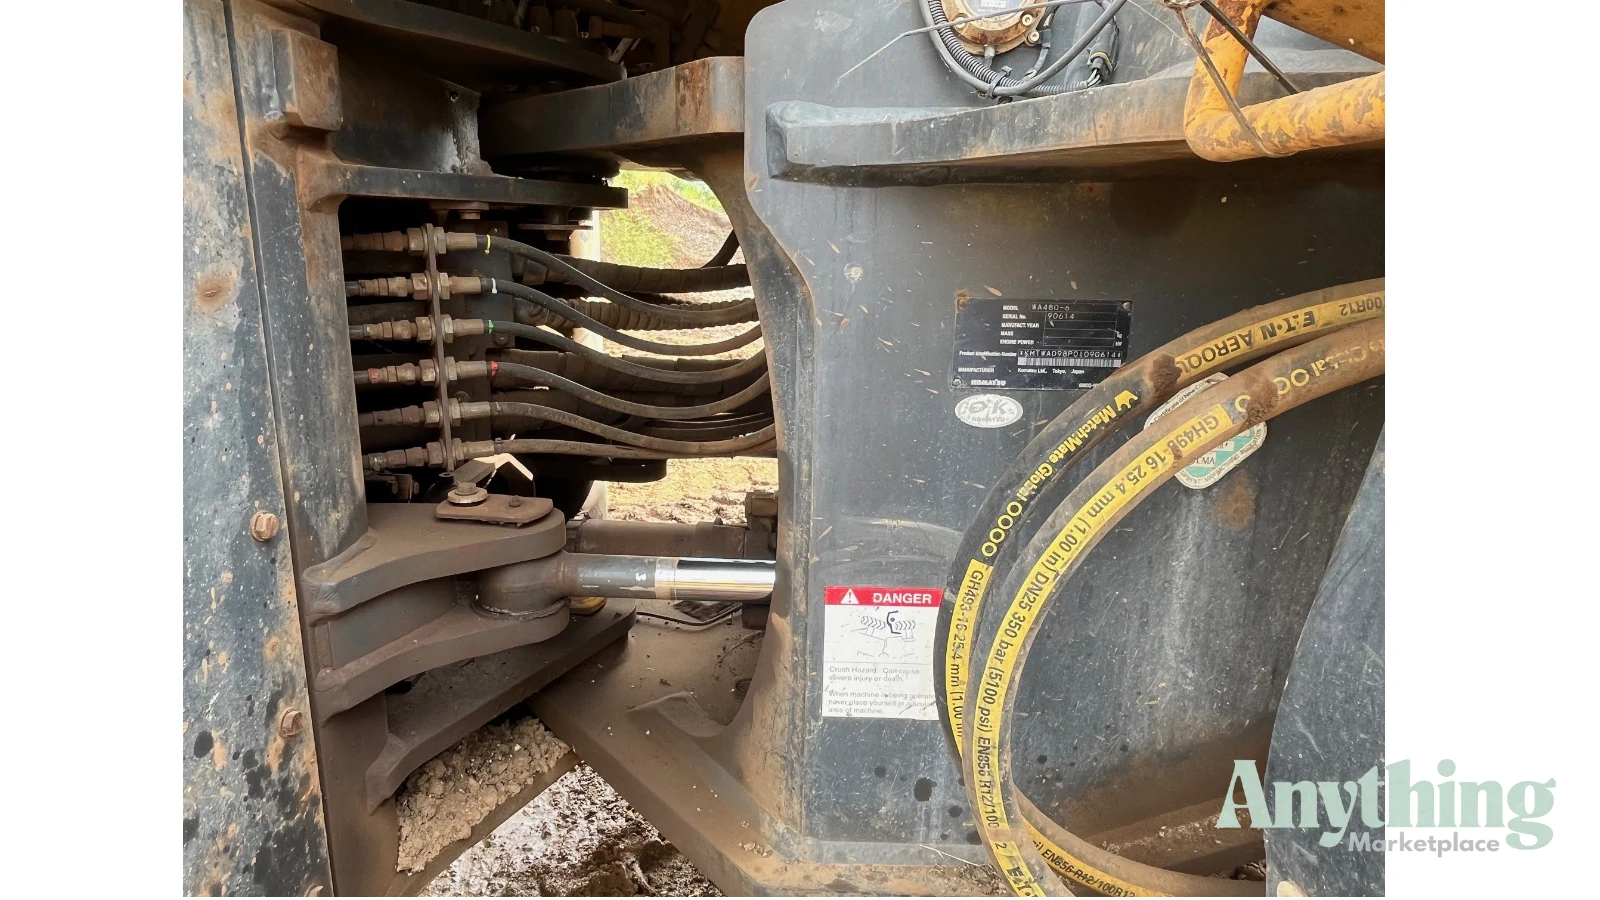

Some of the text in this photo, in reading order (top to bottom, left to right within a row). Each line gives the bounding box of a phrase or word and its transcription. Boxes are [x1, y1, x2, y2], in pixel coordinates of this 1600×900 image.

[1031, 303, 1070, 311] WA480-6
[1047, 312, 1075, 320] 90614
[1175, 330, 1253, 374] AEROQU
[1048, 405, 1117, 464] MatchMate
[1115, 465, 1148, 495] 25.4
[1086, 490, 1116, 518] mm
[872, 593, 932, 604] DANGER
[1018, 571, 1050, 612] DN25
[1004, 611, 1026, 639] 350
[993, 639, 1014, 664] bar
[853, 675, 873, 683] injury
[950, 664, 960, 687] mm
[984, 666, 1005, 705] (5100
[828, 690, 849, 698] When
[850, 691, 880, 699] machine
[888, 692, 908, 700] being
[910, 693, 936, 701] operate
[848, 700, 869, 708] place
[977, 706, 993, 733] psi)
